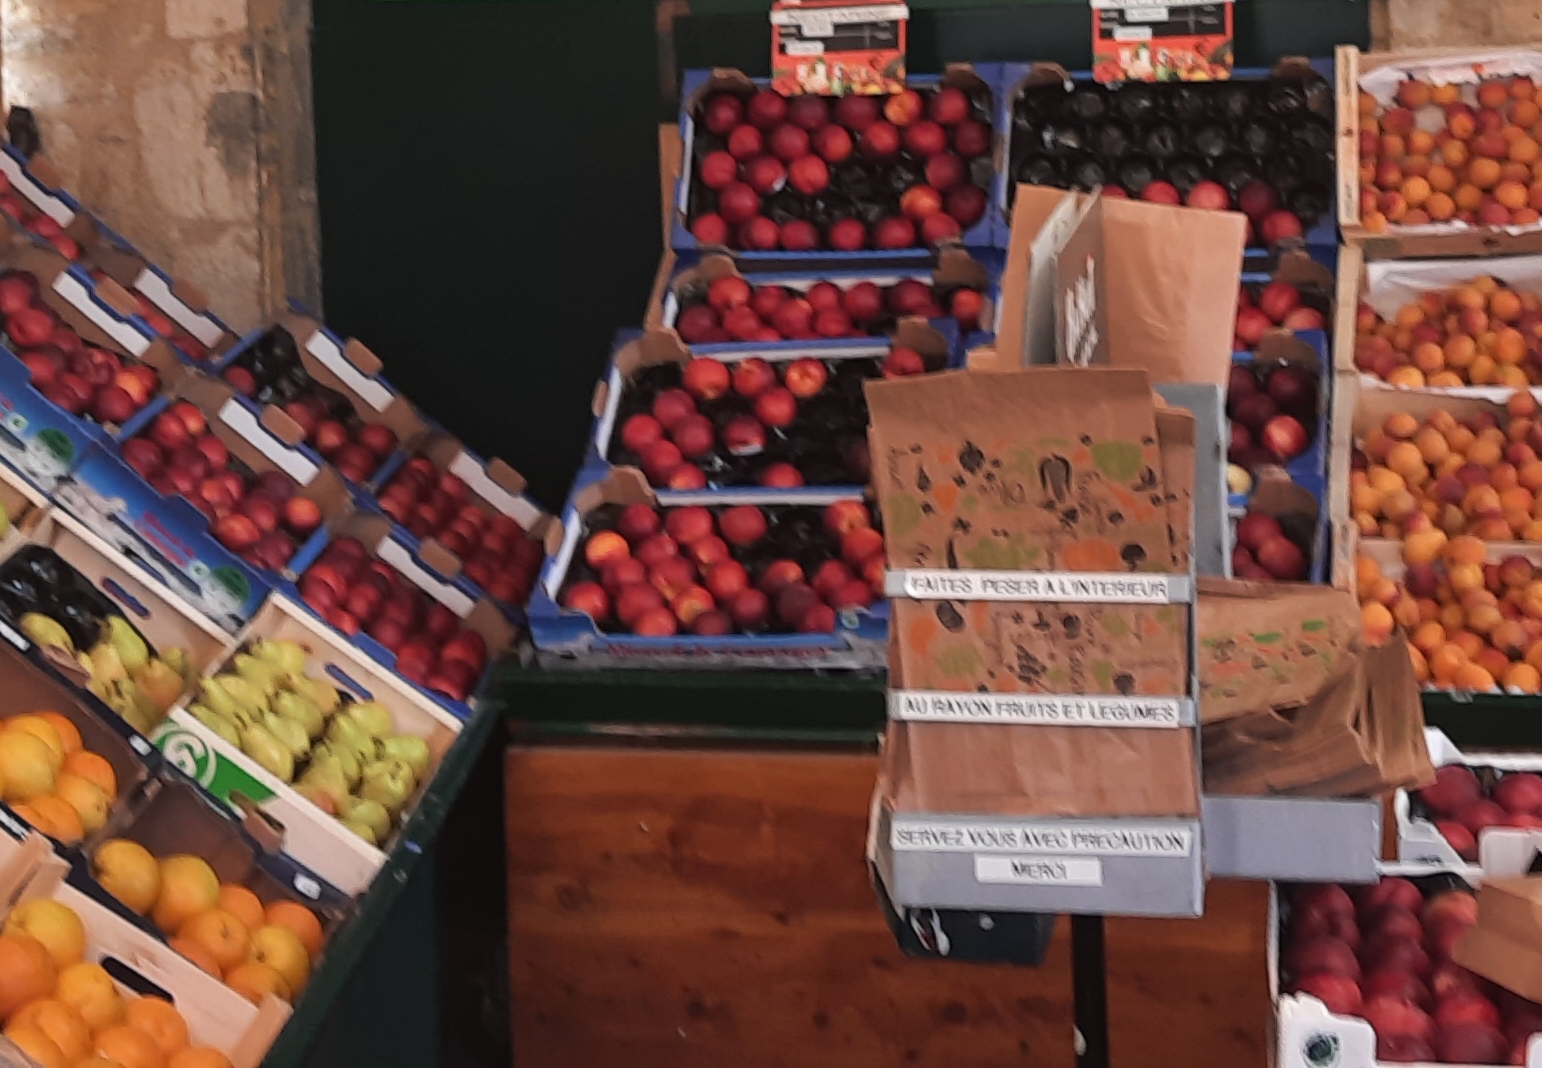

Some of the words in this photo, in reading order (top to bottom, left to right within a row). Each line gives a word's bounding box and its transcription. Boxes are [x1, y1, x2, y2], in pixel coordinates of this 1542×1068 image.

[911, 577, 973, 593] FAITES
[980, 579, 1040, 595] PESER
[1044, 580, 1056, 595] A
[904, 697, 928, 713] AU
[932, 699, 991, 715] RAYON
[995, 701, 1058, 718] FRUITS
[1062, 704, 1084, 720] ET
[1088, 705, 1175, 722] LEGUMES
[896, 827, 964, 846] SERVEZ
[967, 830, 1018, 848] VOUS
[1021, 831, 1068, 849] AVEC
[1071, 832, 1185, 851] PRECAUTION
[1010, 859, 1068, 880] MERCI
